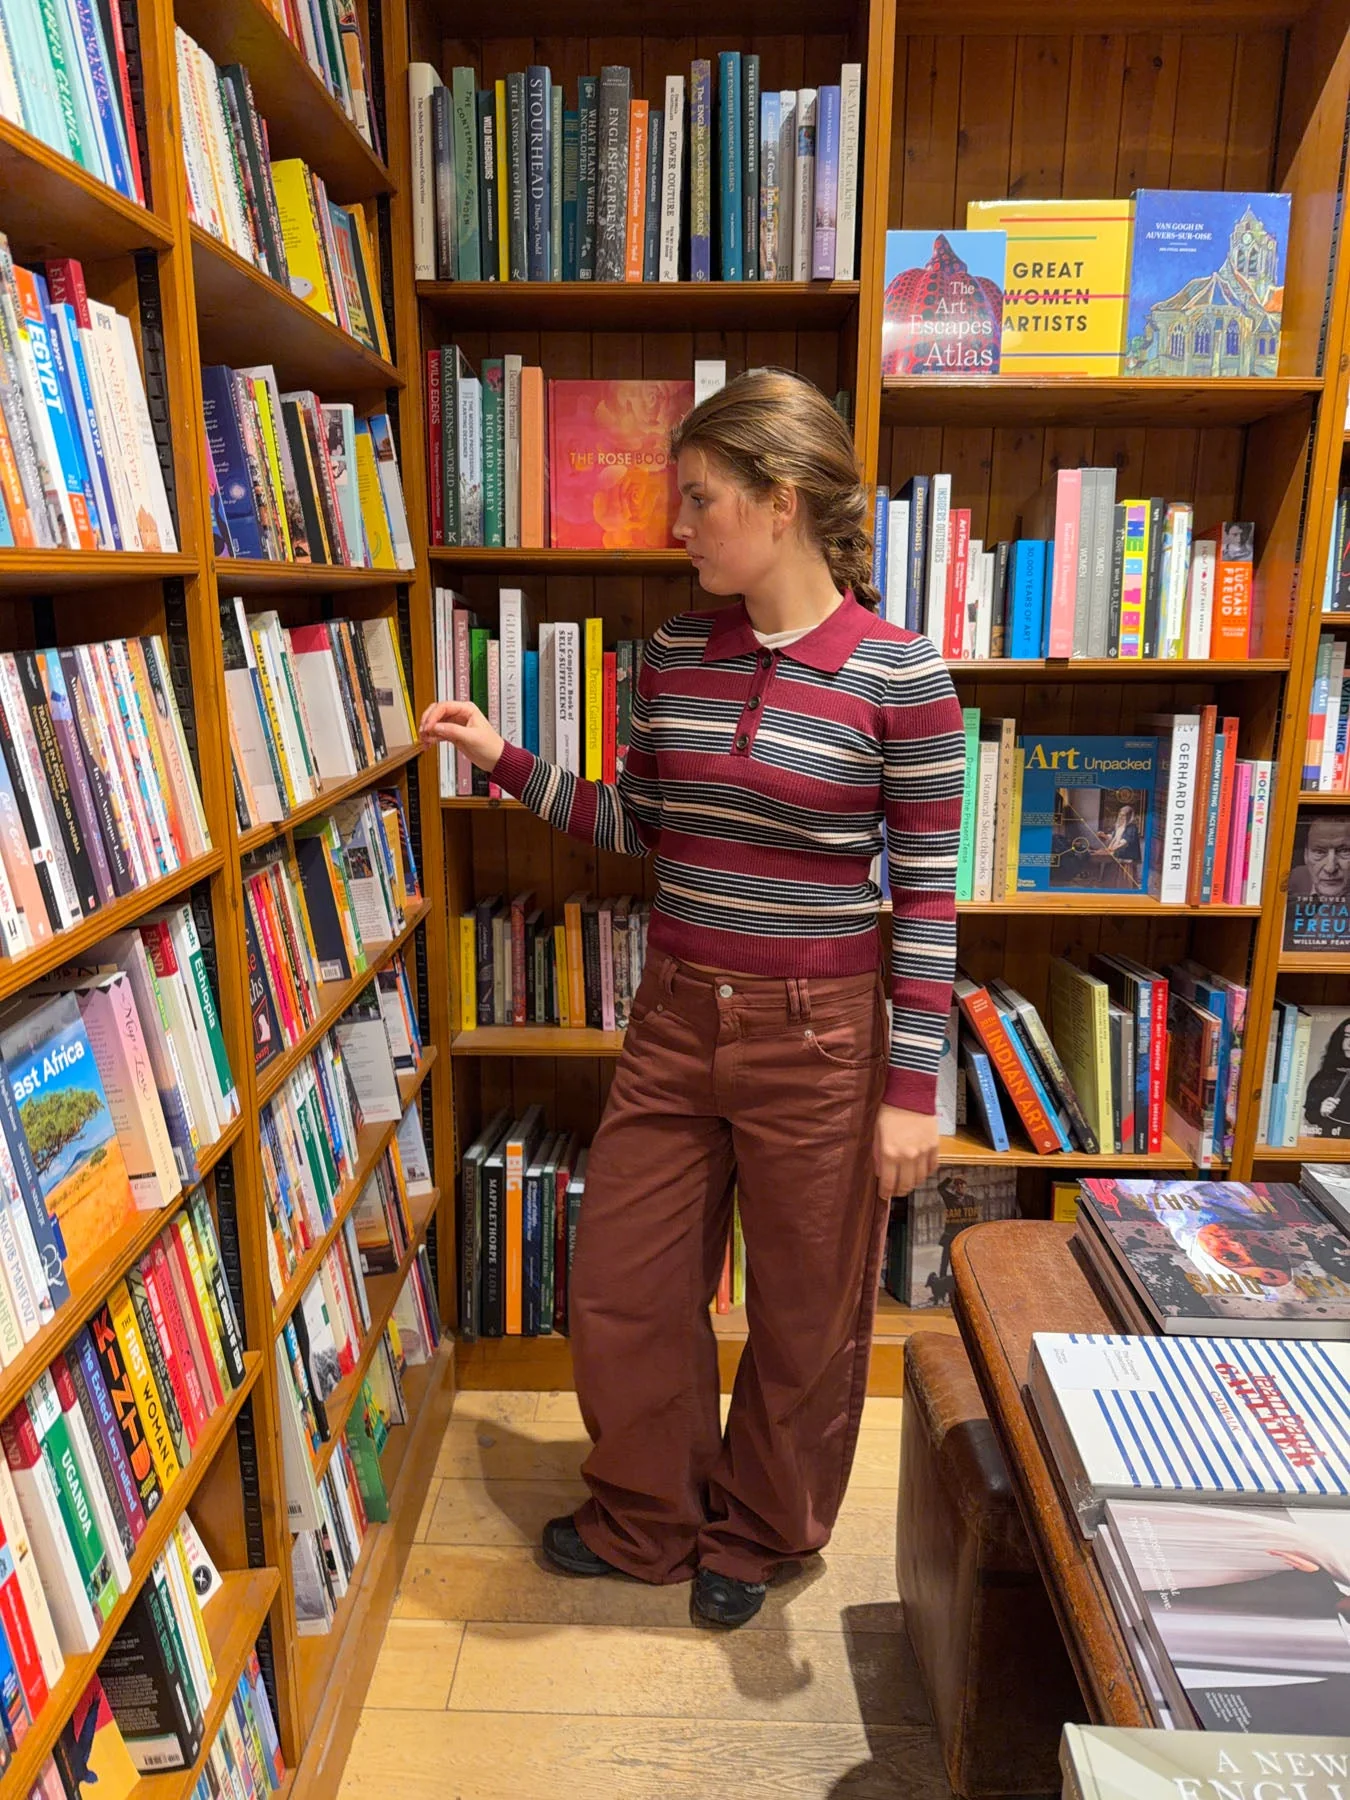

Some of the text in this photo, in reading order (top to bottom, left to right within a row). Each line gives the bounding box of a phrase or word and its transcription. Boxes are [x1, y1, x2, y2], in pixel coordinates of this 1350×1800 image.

[418, 97, 426, 109] The
[748, 84, 756, 118] SECRET
[848, 78, 860, 98] The
[847, 102, 860, 121] Art
[418, 135, 427, 168] Sherwood
[455, 91, 475, 225] THE CONTEMPORARY GARDEN
[483, 115, 495, 180] WILD NEIGHBOURS
[509, 83, 525, 221] THE LANDSCAPE OF HOME
[579, 107, 588, 182] ENCYCLOPEDIA
[652, 118, 660, 156] GROUNDED
[667, 130, 678, 171] FLOWER
[748, 119, 756, 174] GARDENERS
[845, 137, 858, 161] Fine
[529, 78, 545, 255] STOURHEAD Dudley Dodd
[586, 107, 597, 225] WHAT PLANT WHERE
[606, 107, 619, 241] ENGLISH GARDENS
[650, 175, 658, 203] GARDEN
[666, 172, 677, 218] COUTURE
[842, 163, 858, 222] Gardening
[1145, 230, 1214, 241] AUVERS-SUR-OISE
[1155, 222, 1205, 232] VAN GOGH IN
[950, 280, 976, 297] The
[1012, 261, 1085, 279] GREAT
[935, 299, 967, 315] Art
[1004, 288, 1090, 306] WOMEN
[909, 315, 992, 338] Escapes
[1002, 314, 1088, 332] ARTISTS
[26, 323, 64, 416] EGYPT
[50, 327, 66, 372] Egypt
[923, 341, 994, 368] Atlas
[430, 358, 441, 425] WILD EDENS
[508, 369, 518, 441] Beatrix Farrand
[88, 408, 104, 459] EGYPT
[445, 348, 456, 488] ROYAL GARDENS WORLD
[486, 413, 494, 513] RICHARD MABEY
[570, 453, 676, 465] THE ROSE BOO
[914, 487, 924, 551] EXPRESSIONISTS
[935, 487, 948, 563] INSIDERS OUTSIDERS
[960, 519, 968, 532] Art
[958, 534, 967, 557] Fraud
[1079, 546, 1089, 578] WOMEN
[1095, 546, 1105, 577] WOMEN
[1023, 546, 1034, 642] 30,000 YEARS OF ART
[1221, 567, 1233, 616] FREUD
[1233, 567, 1244, 616] LUCIAN
[254, 643, 284, 754] DON'T LET GO
[506, 613, 517, 744] GLORIOUS GARDENS
[559, 630, 567, 721] SELF-SUFFICIENCY
[566, 631, 574, 721] The Complete Book of
[589, 667, 600, 749] Dream Gardens
[1335, 680, 1350, 753] WILD THING
[37, 704, 82, 854] TRAVELS IN EGYPT AND NUBIA
[93, 766, 102, 779] In
[966, 757, 976, 785] Drawing
[1024, 743, 1152, 773] Art Unpacked
[1211, 749, 1223, 807] ANDREW FESTING
[96, 781, 106, 798] an
[1170, 743, 1190, 871] GERHARD RICHTER
[1255, 771, 1268, 825] HOCKNEY
[98, 803, 117, 842] Antique
[963, 812, 972, 841] Present
[979, 773, 993, 880] Botanical Sketchbooks
[110, 845, 127, 876] Land
[962, 842, 970, 864] Tense
[1292, 918, 1350, 933] FREU
[1294, 903, 1350, 918] LUCIA
[181, 907, 218, 1030] Bradt Ethiopia
[13, 1039, 85, 1101] ast Africa
[121, 1003, 152, 1102] Map Love
[986, 1027, 1050, 1133] INDIAN ART
[17, 1142, 34, 1185] MICHAEL
[1125, 1193, 1203, 1212] GAZA
[9, 1262, 36, 1328] MAHFOUZ
[1183, 1272, 1267, 1296] DAYS
[121, 1314, 133, 1330] THE
[37, 1374, 55, 1416] Bradt
[80, 1338, 96, 1372] The
[90, 1371, 112, 1424] Exiled
[92, 1306, 152, 1482] KINTU
[124, 1327, 172, 1463] FIRST WOMAN
[1210, 1390, 1241, 1433] CATWALK
[60, 1447, 93, 1538] UGANDA
[106, 1426, 138, 1513] Lucy Fulford
[1217, 1749, 1348, 1778] A NEW
